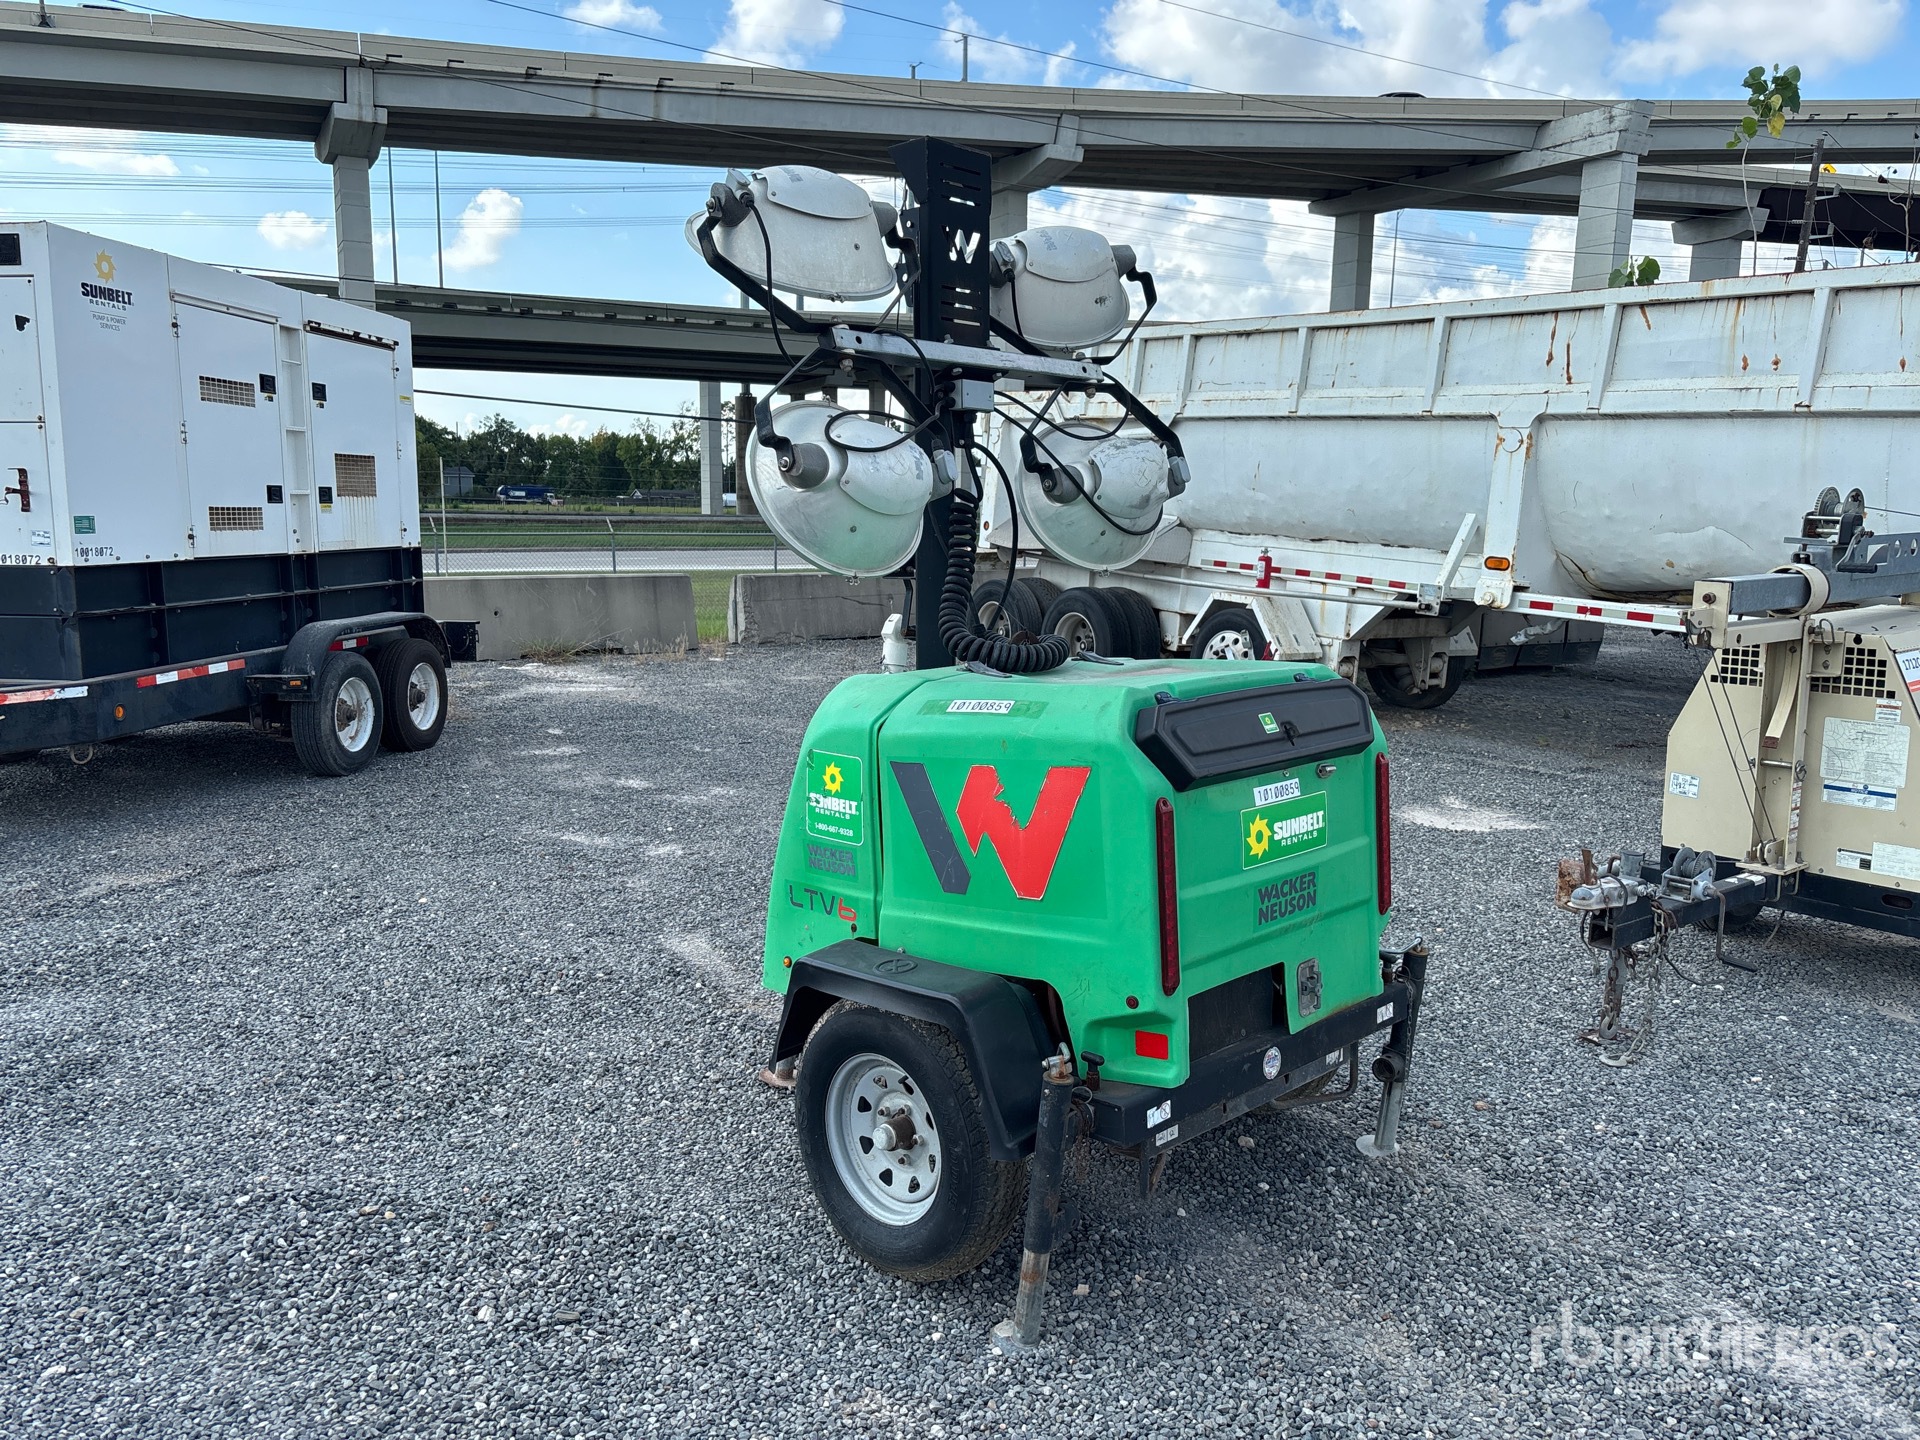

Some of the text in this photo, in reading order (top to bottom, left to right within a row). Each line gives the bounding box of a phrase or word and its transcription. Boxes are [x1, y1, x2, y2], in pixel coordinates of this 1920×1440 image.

[80, 281, 133, 306] SUNBELT
[89, 298, 127, 311] RENTALS
[92, 313, 106, 321] PUMP
[110, 317, 126, 325] POWER
[99, 322, 121, 332] SERVICES
[74, 546, 114, 558] 10018072
[951, 701, 1012, 712] 10100859
[1257, 781, 1300, 802] 10100859
[815, 807, 850, 820] RENTALS
[814, 821, 854, 837] 1-800-667-9328
[1273, 810, 1324, 841] SUNBELT
[1281, 830, 1318, 847] RENTALS
[807, 843, 855, 864] WACKER
[808, 856, 857, 877] NEUSON
[1257, 871, 1317, 906] WACKER
[789, 884, 857, 922] LTV6
[1257, 888, 1317, 926] NEUSON
